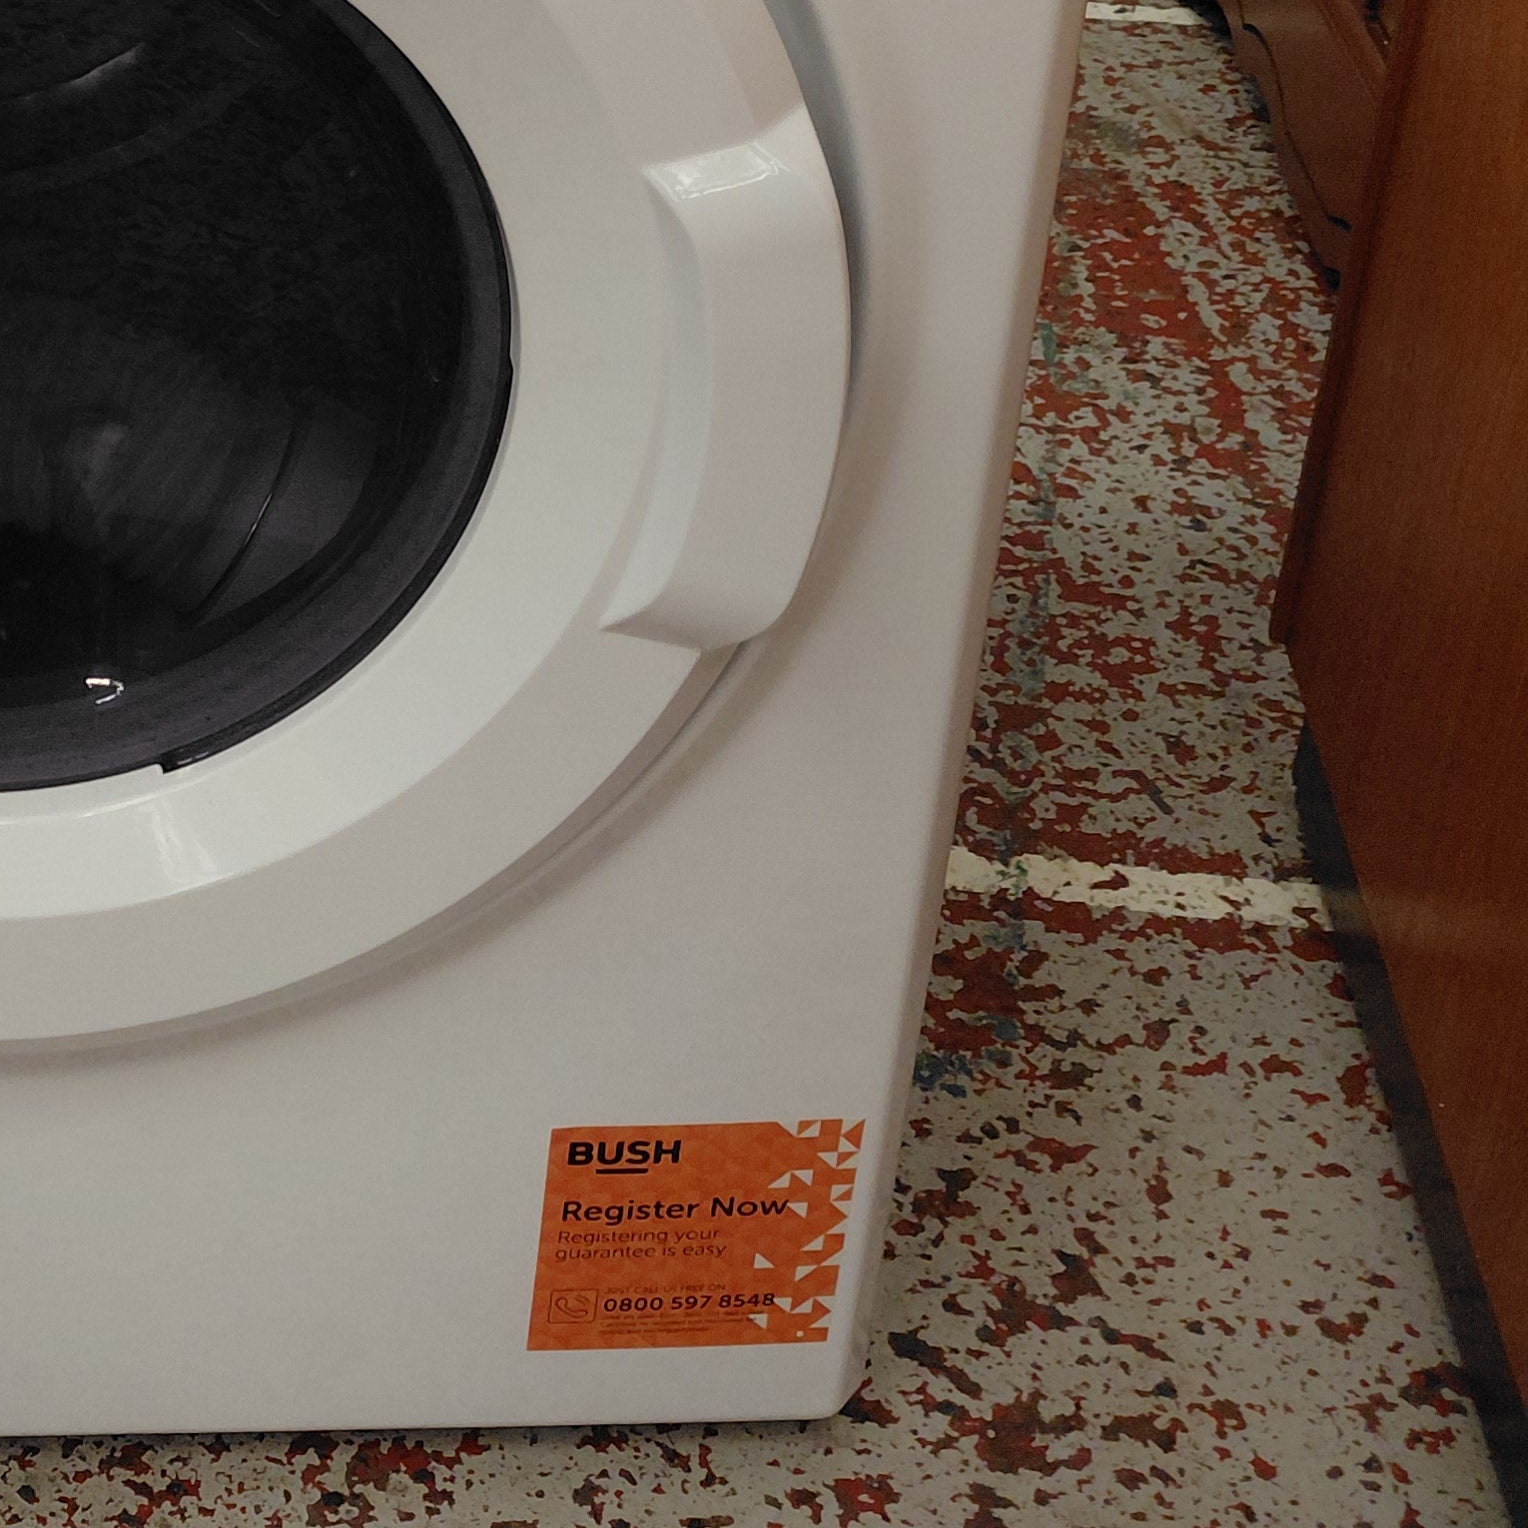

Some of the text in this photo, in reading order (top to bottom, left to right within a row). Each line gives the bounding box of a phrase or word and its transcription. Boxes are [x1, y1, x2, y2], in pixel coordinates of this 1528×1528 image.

[567, 1140, 682, 1166] BUSH
[561, 1197, 790, 1226] Register Now
[558, 1228, 720, 1246] Registering your
[555, 1244, 727, 1262] guarantee is easy
[603, 1293, 776, 1312] 0800 597 8548
